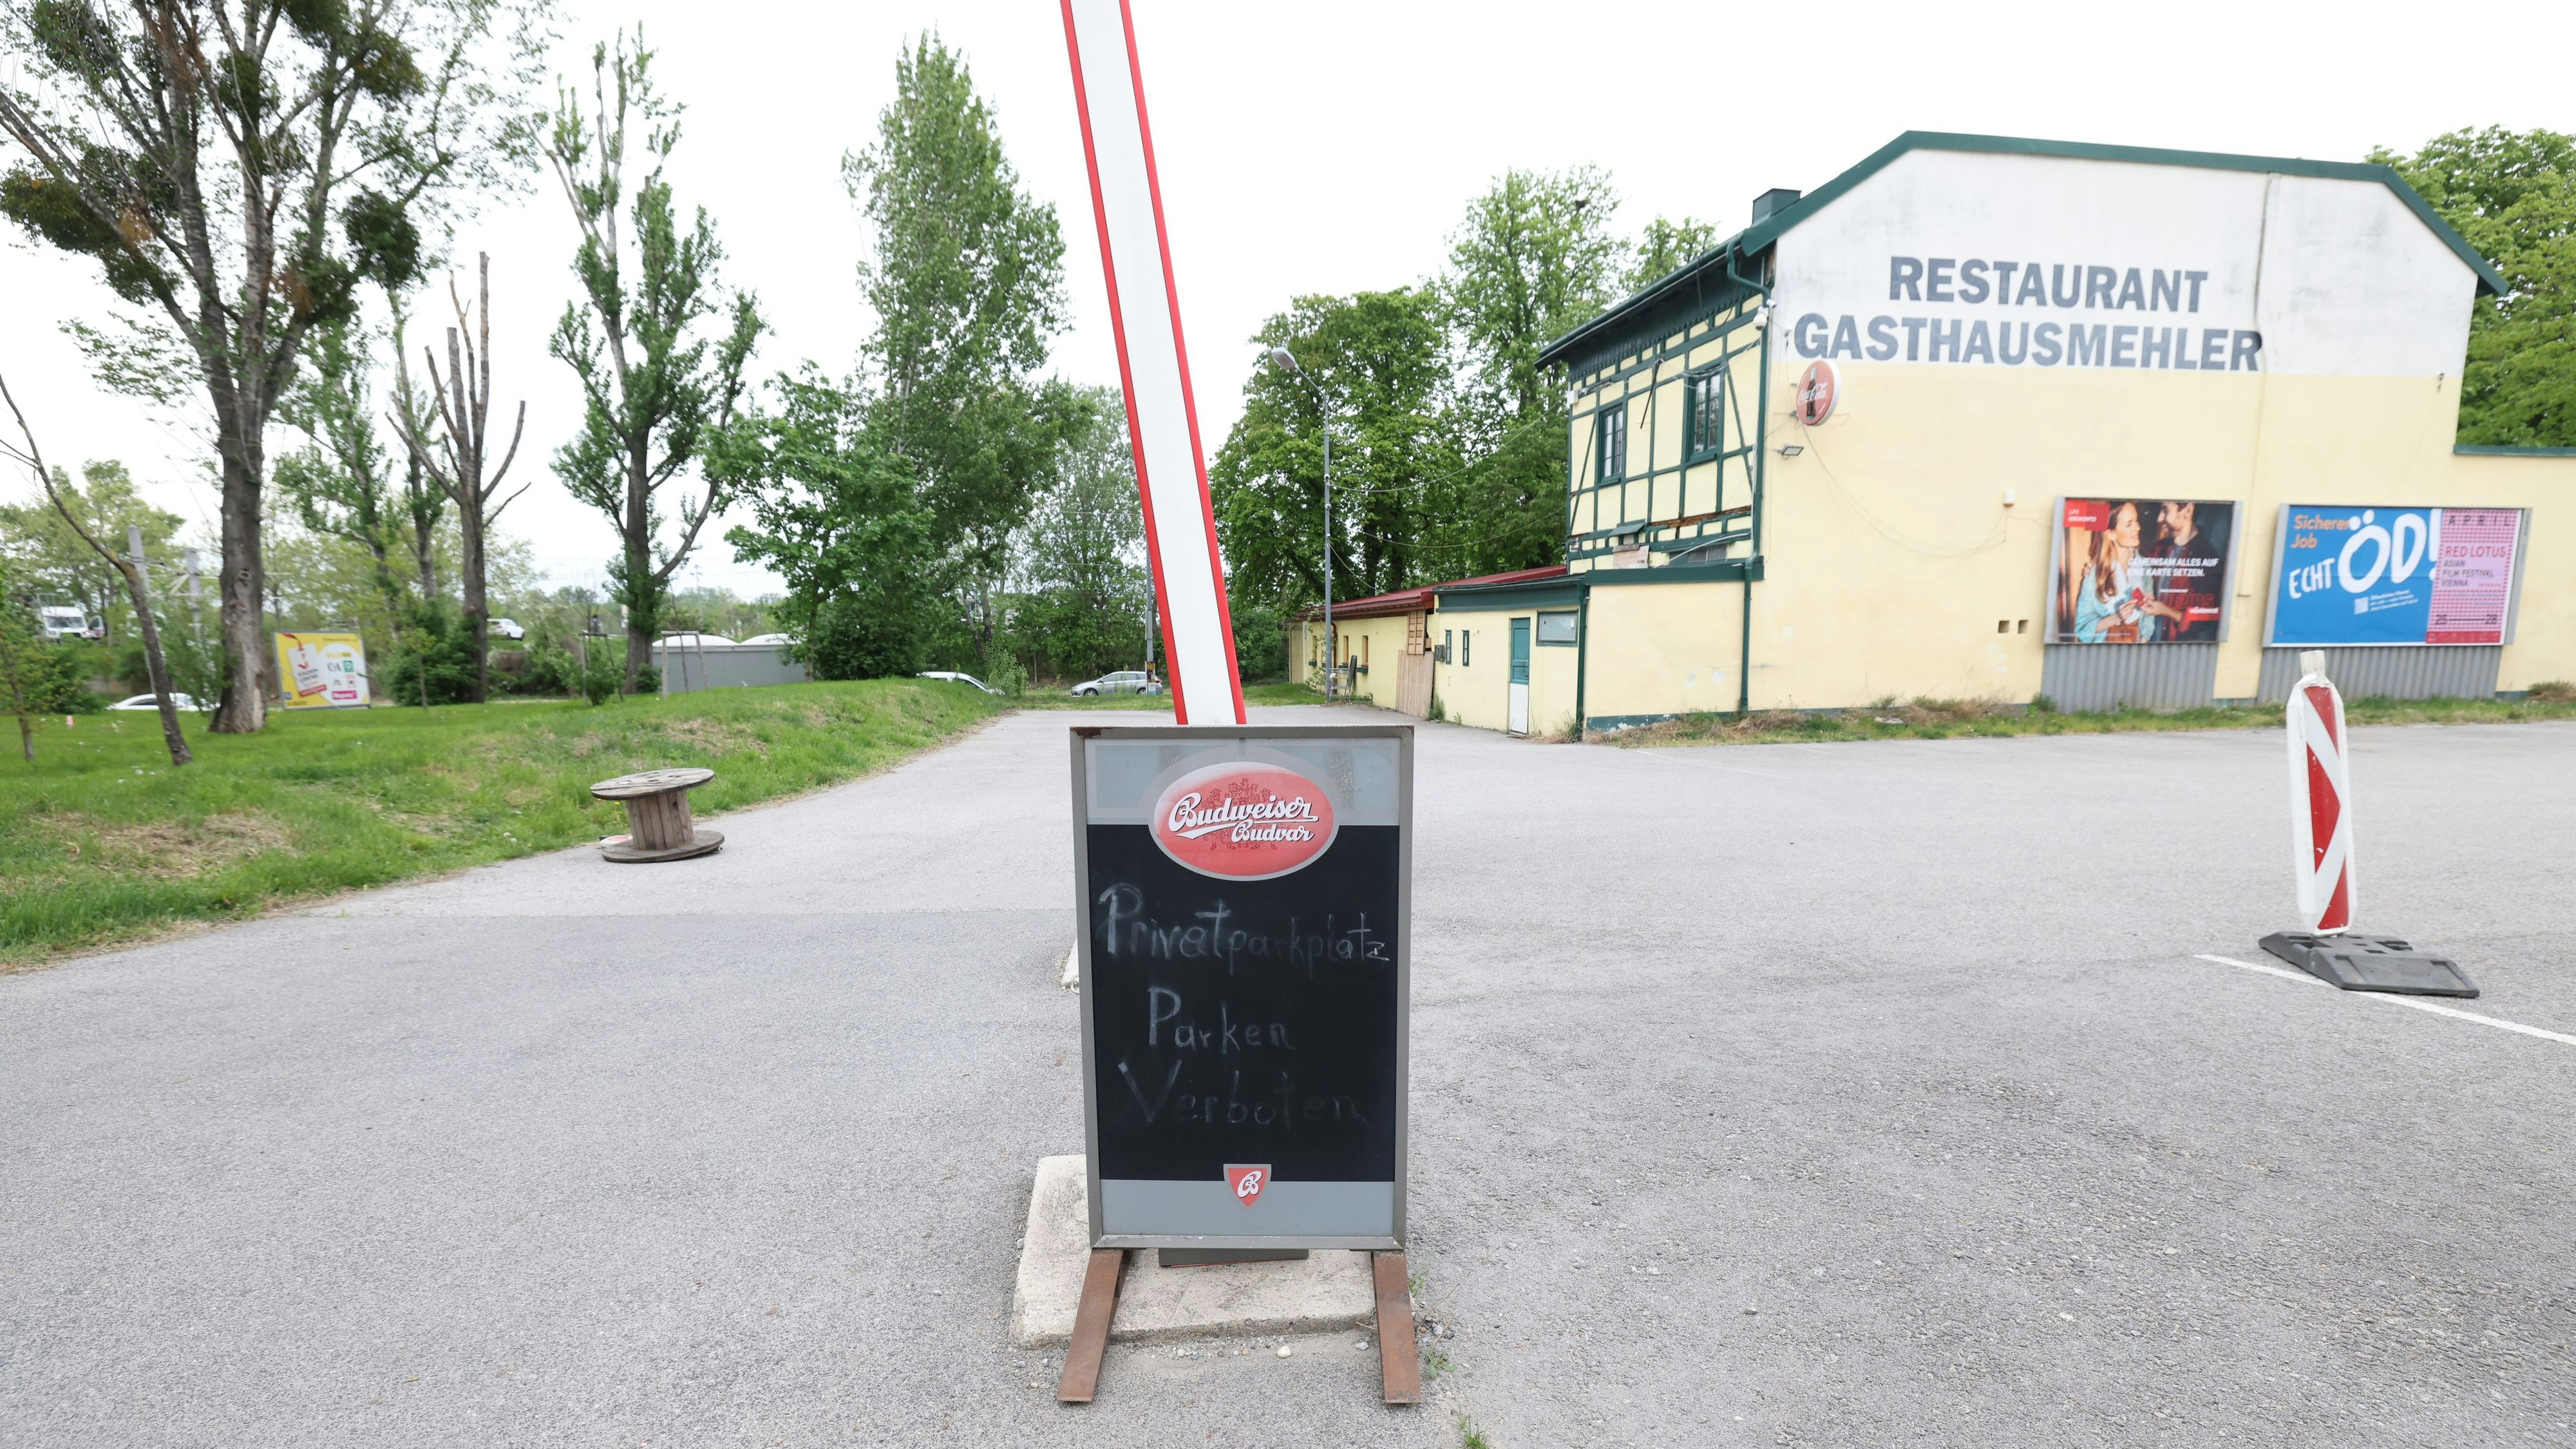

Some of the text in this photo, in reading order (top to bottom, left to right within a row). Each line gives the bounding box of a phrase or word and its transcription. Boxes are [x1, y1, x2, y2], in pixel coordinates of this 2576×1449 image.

[1889, 256, 2209, 313] RESTAURANT
[1793, 313, 2263, 372] GASTHAUSMEHLER
[2290, 533, 2318, 549] Job
[2445, 545, 2506, 557] RED LOTUS
[2146, 568, 2173, 576] KARTE
[2176, 558, 2202, 567] ALLES
[2201, 558, 2219, 567] AUF
[2289, 558, 2335, 599] ECHT
[1168, 791, 1320, 833] Budweiser
[1231, 819, 1315, 843] Budvar
[1097, 882, 1390, 980] Privatparkplatz
[1147, 987, 1296, 1055] Parken
[1117, 1059, 1367, 1127] Verboten
